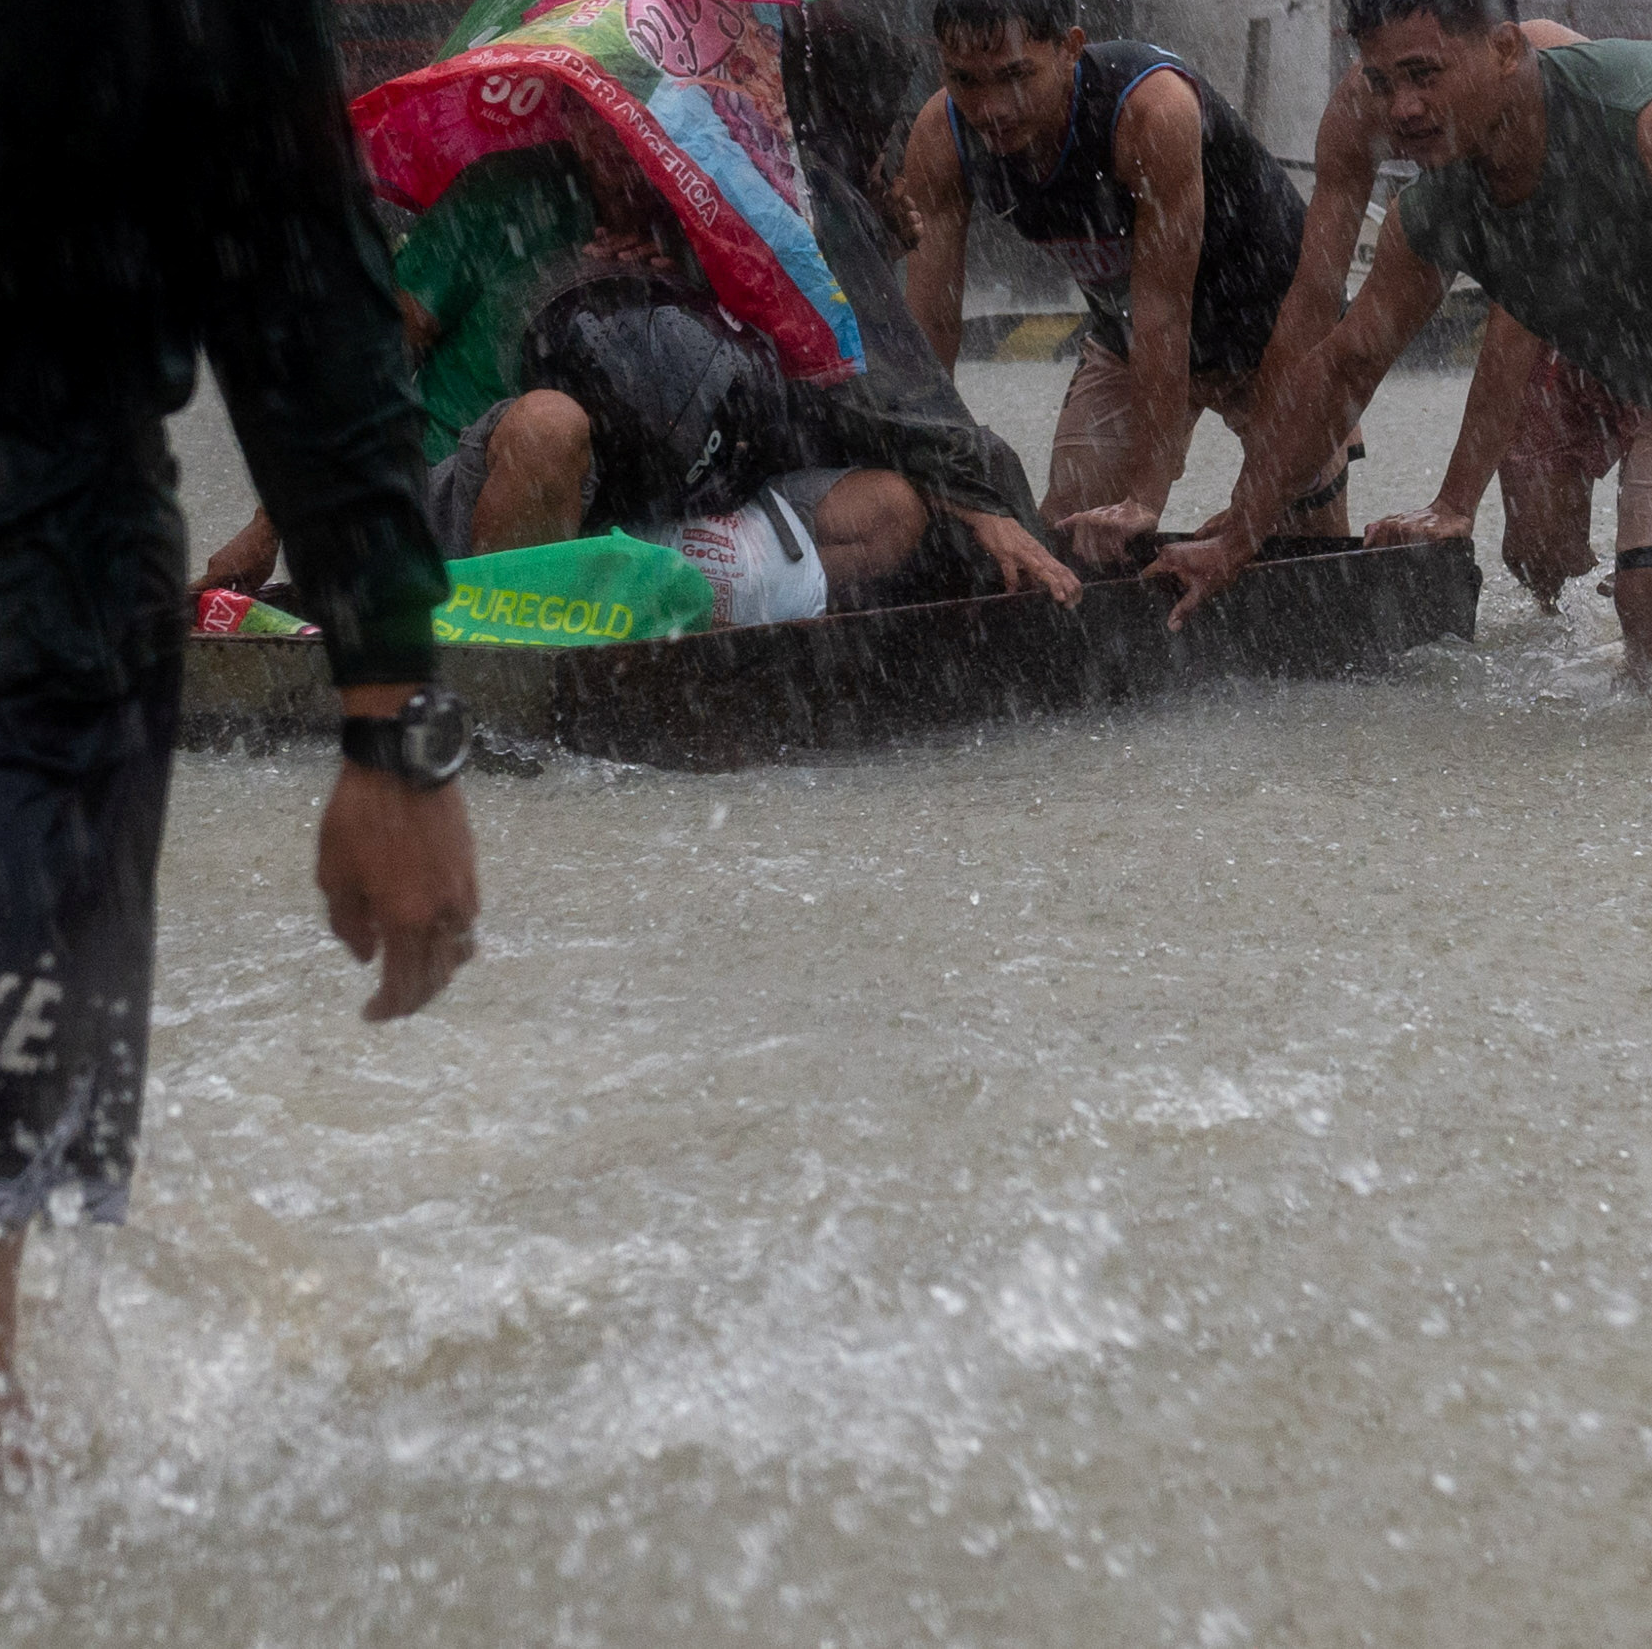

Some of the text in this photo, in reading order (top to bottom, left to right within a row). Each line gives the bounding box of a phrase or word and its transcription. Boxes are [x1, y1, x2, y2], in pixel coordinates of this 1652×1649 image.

[481, 74, 544, 117] 50
[523, 49, 617, 105] SUPER
[614, 102, 720, 227] ANGELICA
[447, 584, 634, 640] PUREGOLD
